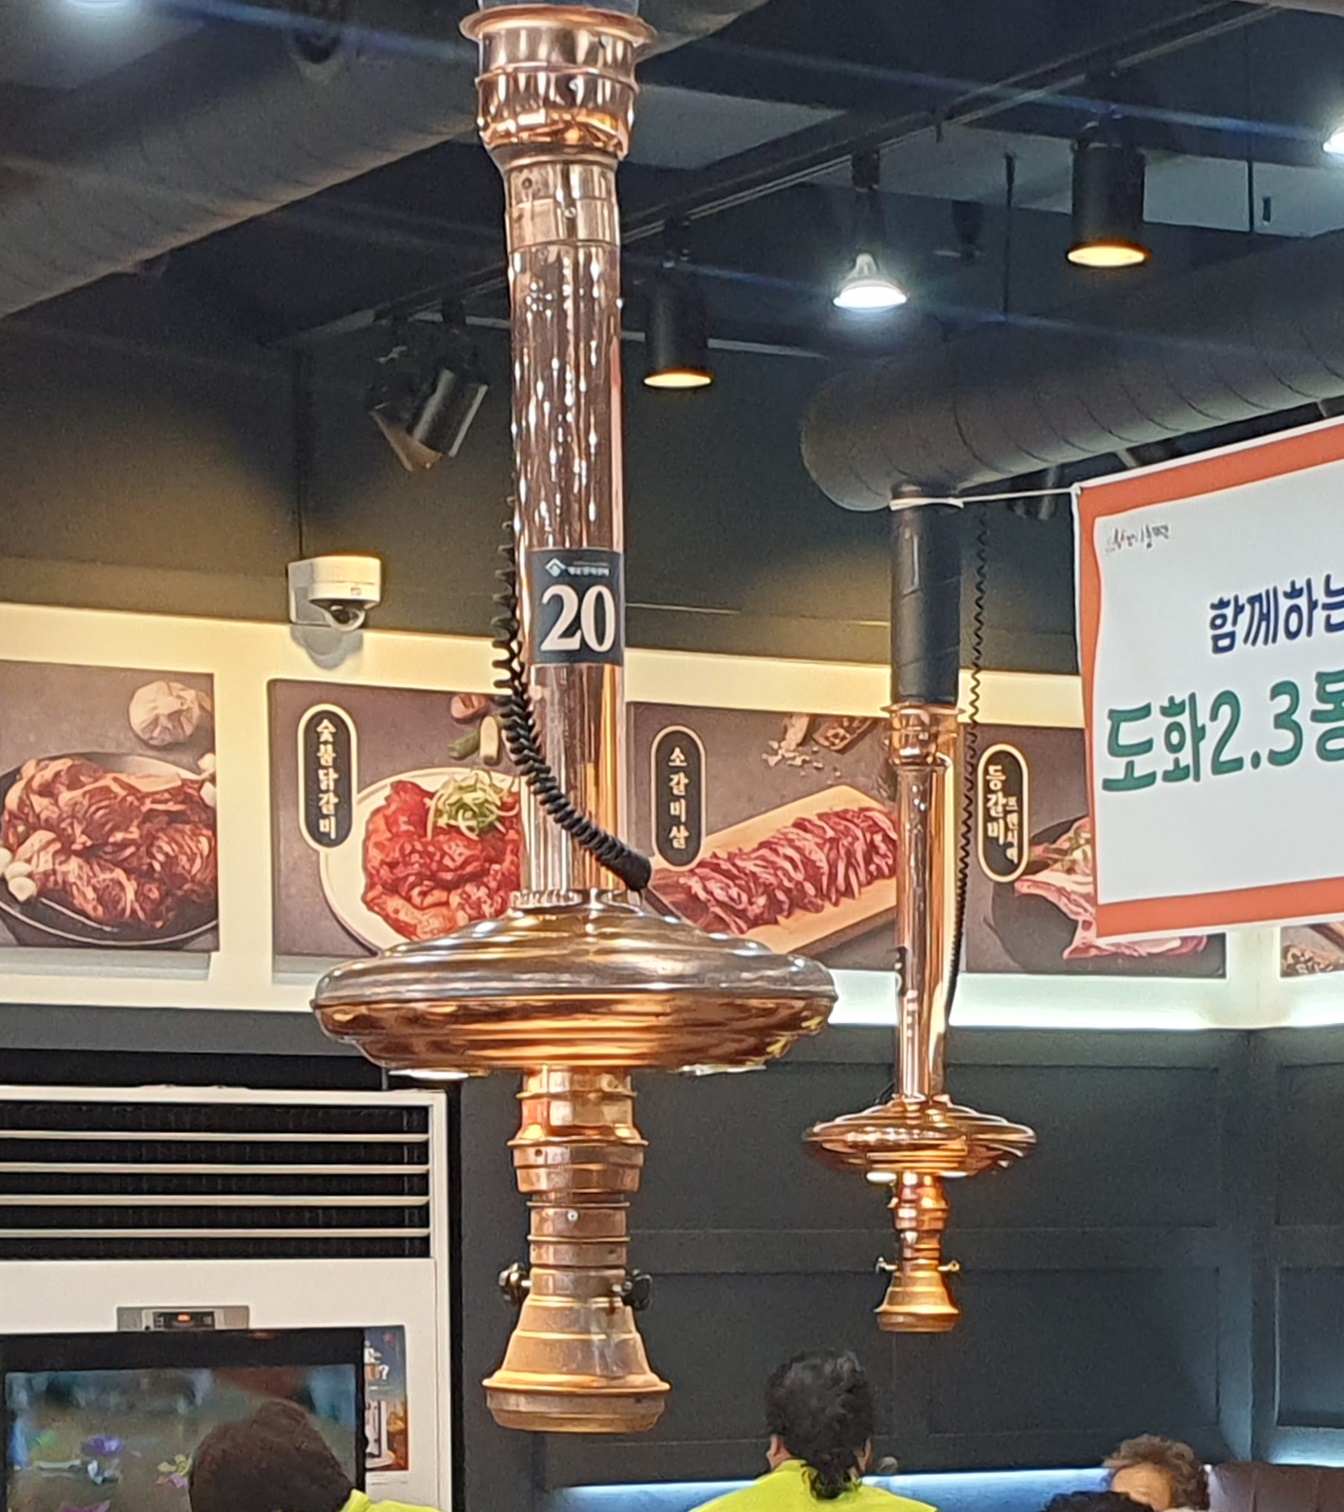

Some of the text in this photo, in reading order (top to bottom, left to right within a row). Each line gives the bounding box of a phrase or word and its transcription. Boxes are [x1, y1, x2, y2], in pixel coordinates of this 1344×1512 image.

[540, 584, 617, 654] 20
[667, 746, 690, 850] 소갈비살
[985, 764, 1007, 846] 등갈비
